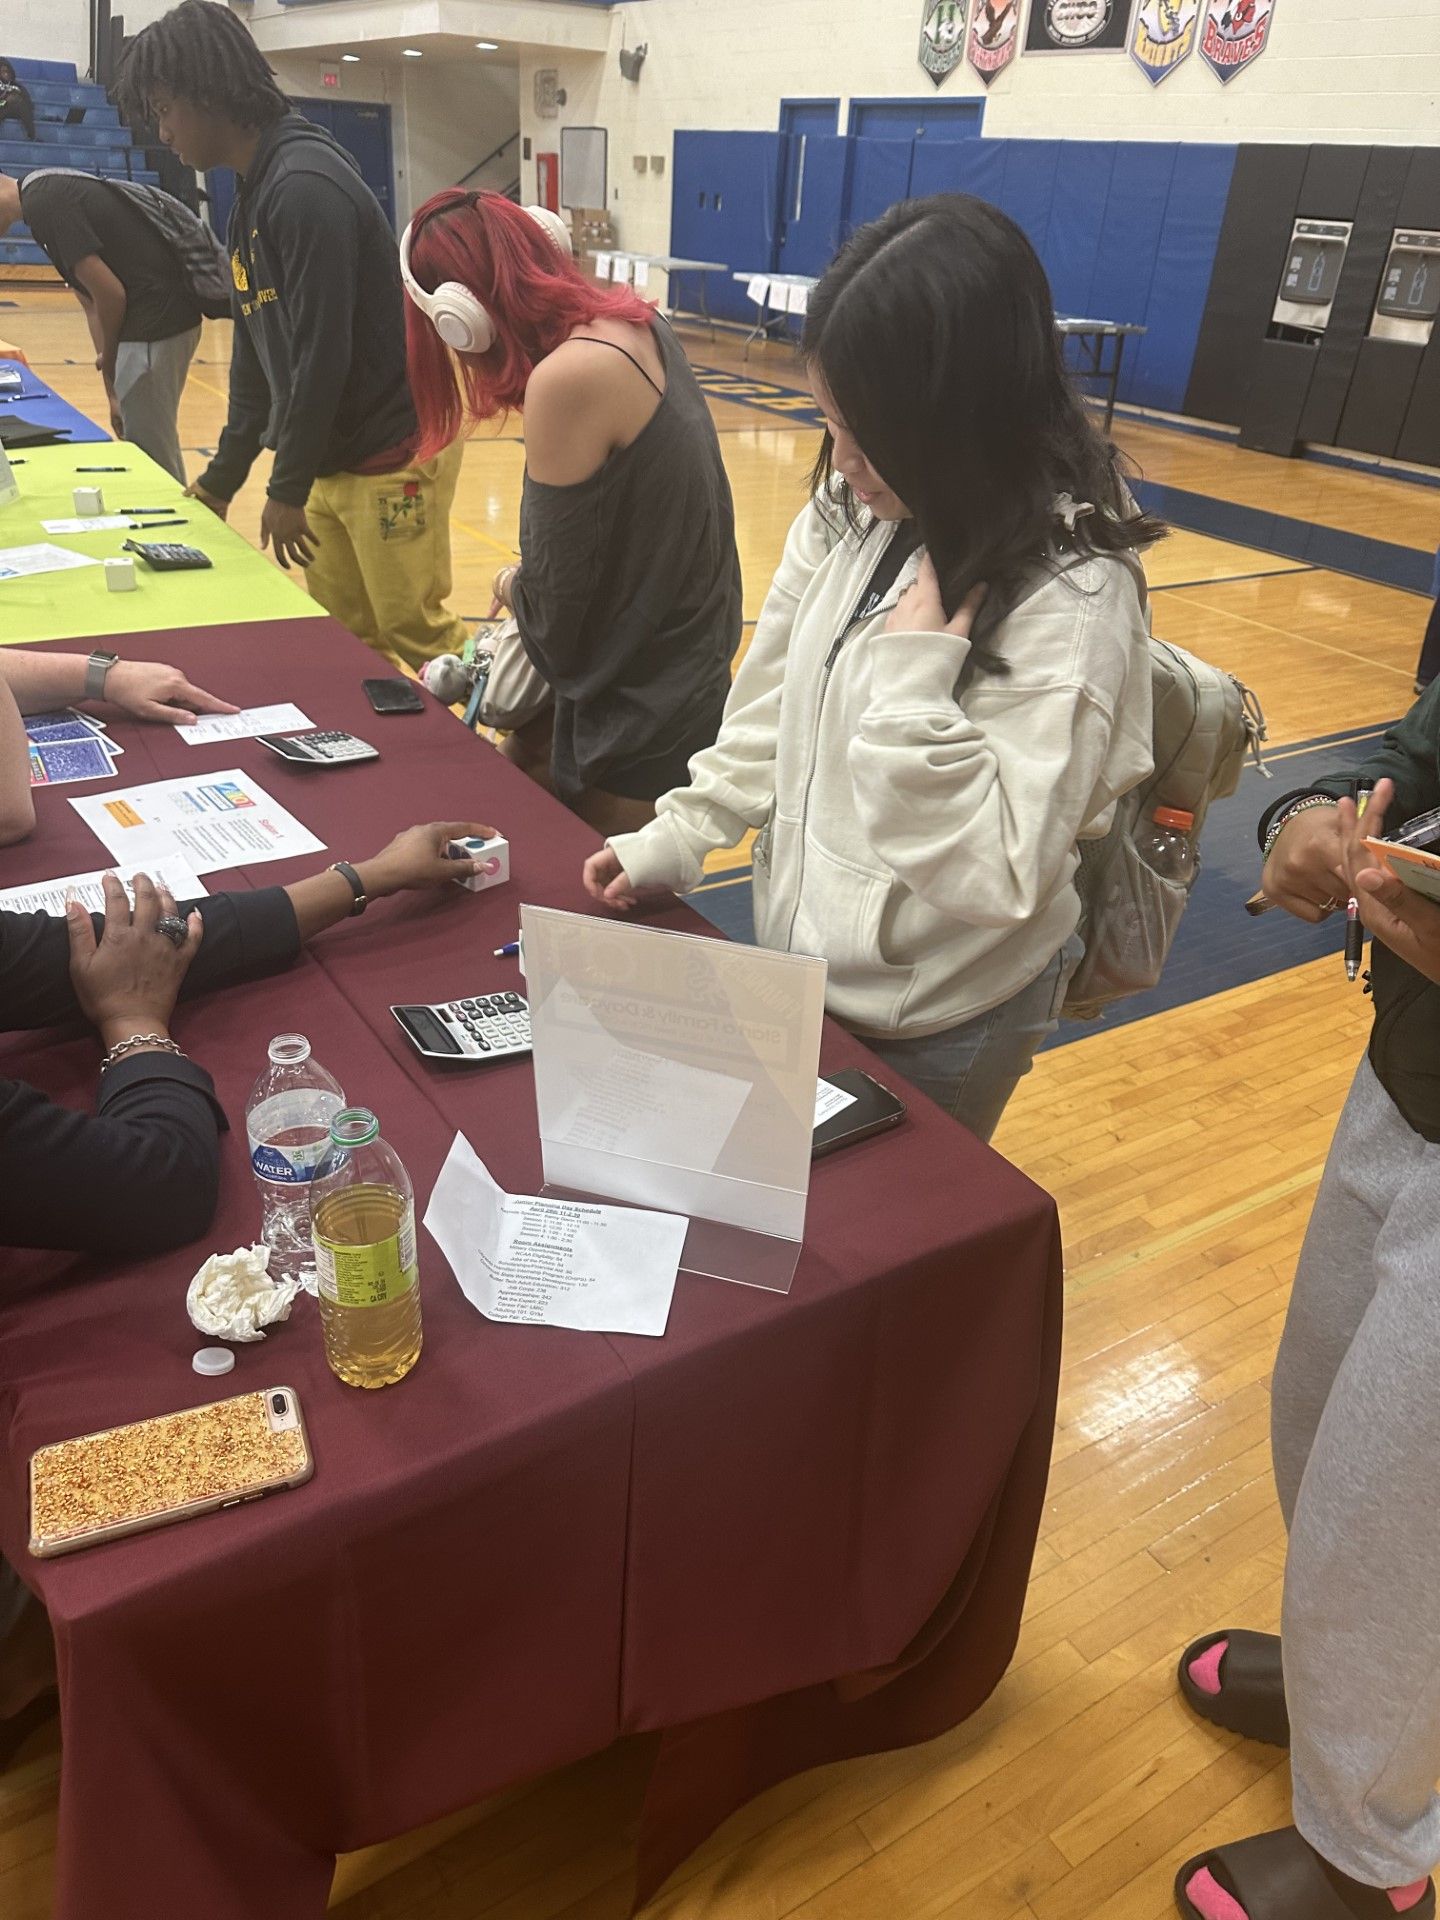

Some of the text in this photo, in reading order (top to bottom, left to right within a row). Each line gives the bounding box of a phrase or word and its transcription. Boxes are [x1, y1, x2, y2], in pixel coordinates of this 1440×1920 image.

[1202, 15, 1268, 65] BRAVES
[253, 1159, 292, 1176] WATER
[574, 1206, 602, 1215] Schedule
